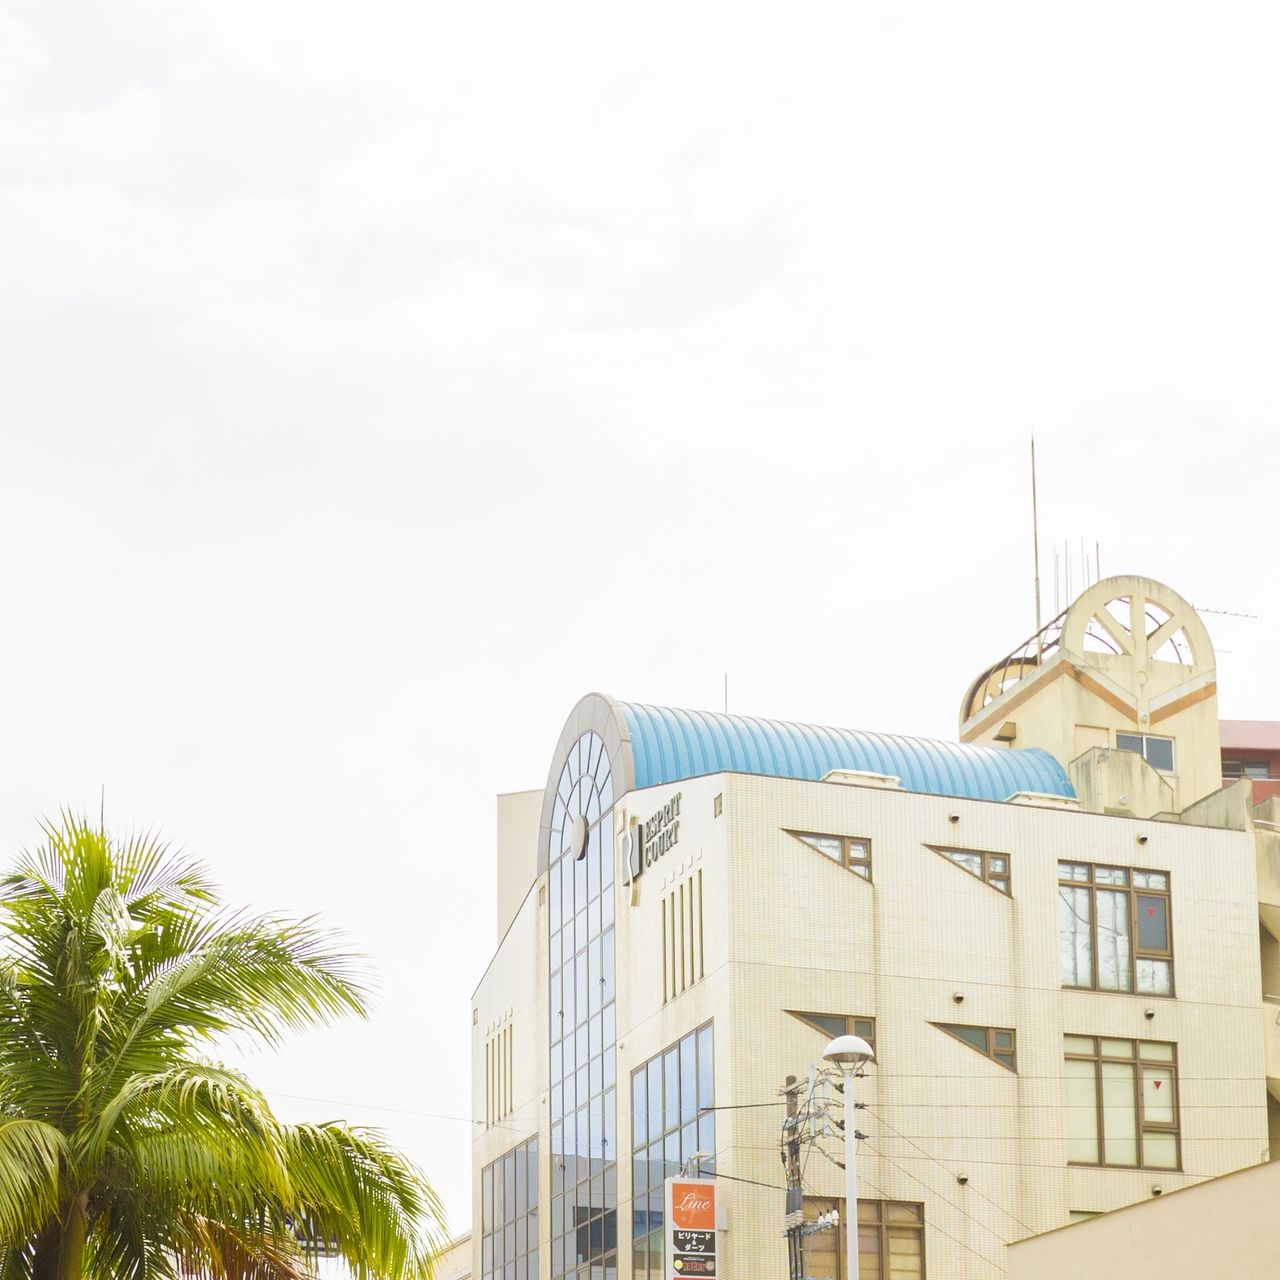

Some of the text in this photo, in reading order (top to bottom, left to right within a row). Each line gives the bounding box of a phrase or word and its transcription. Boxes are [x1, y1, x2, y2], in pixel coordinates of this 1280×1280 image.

[645, 791, 682, 844] ESPRIT
[645, 820, 679, 868] COURT
[678, 1231, 712, 1240] ビリヤード
[684, 1244, 705, 1252] ダーツ
